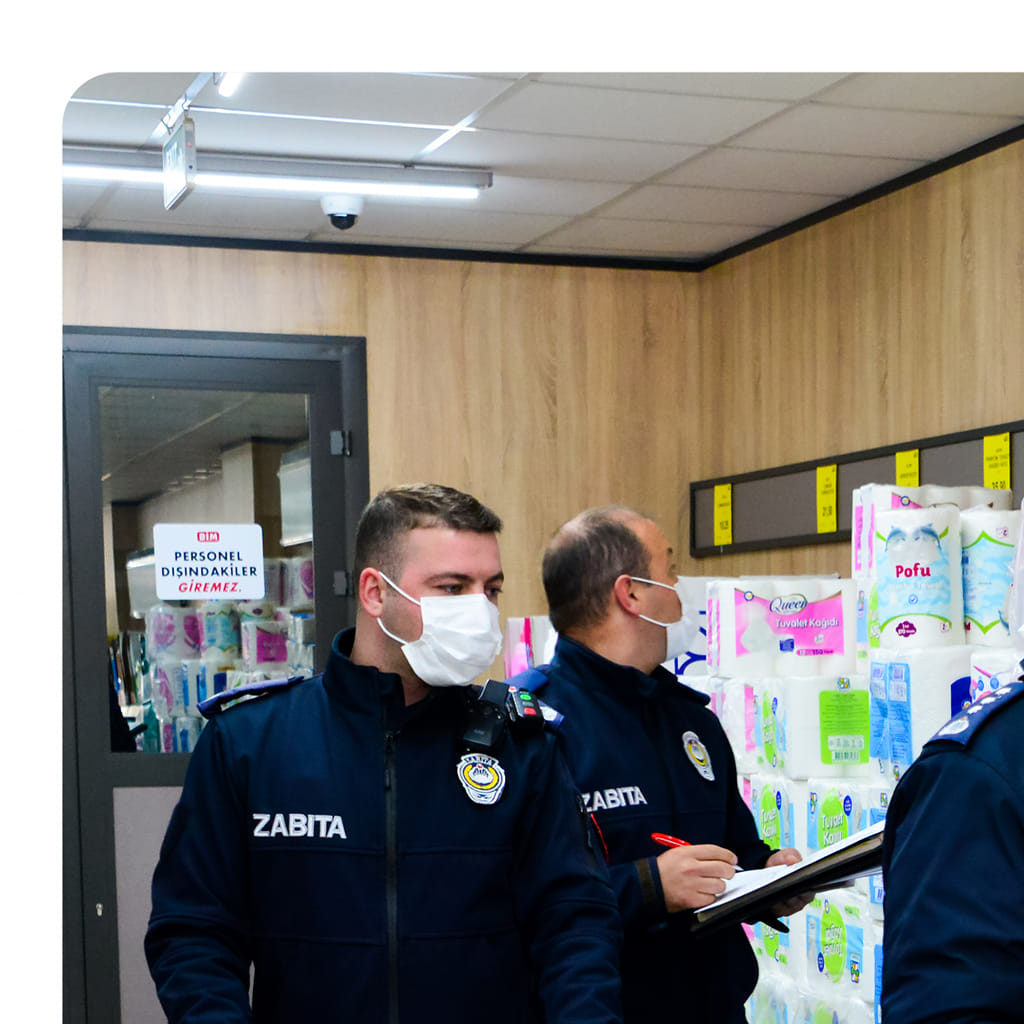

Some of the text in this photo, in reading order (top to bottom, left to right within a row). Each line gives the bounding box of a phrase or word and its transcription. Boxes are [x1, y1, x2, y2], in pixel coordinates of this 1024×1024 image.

[174, 551, 243, 561] PERSONEL
[161, 563, 258, 579] DIŞINDAKİLER
[895, 563, 931, 578] Pofu
[178, 579, 242, 593] GİREMEZ.
[769, 595, 808, 613] Queen
[776, 618, 808, 629] Tuvalet
[579, 785, 648, 813] ZABITA
[252, 812, 348, 840] ZABITA
